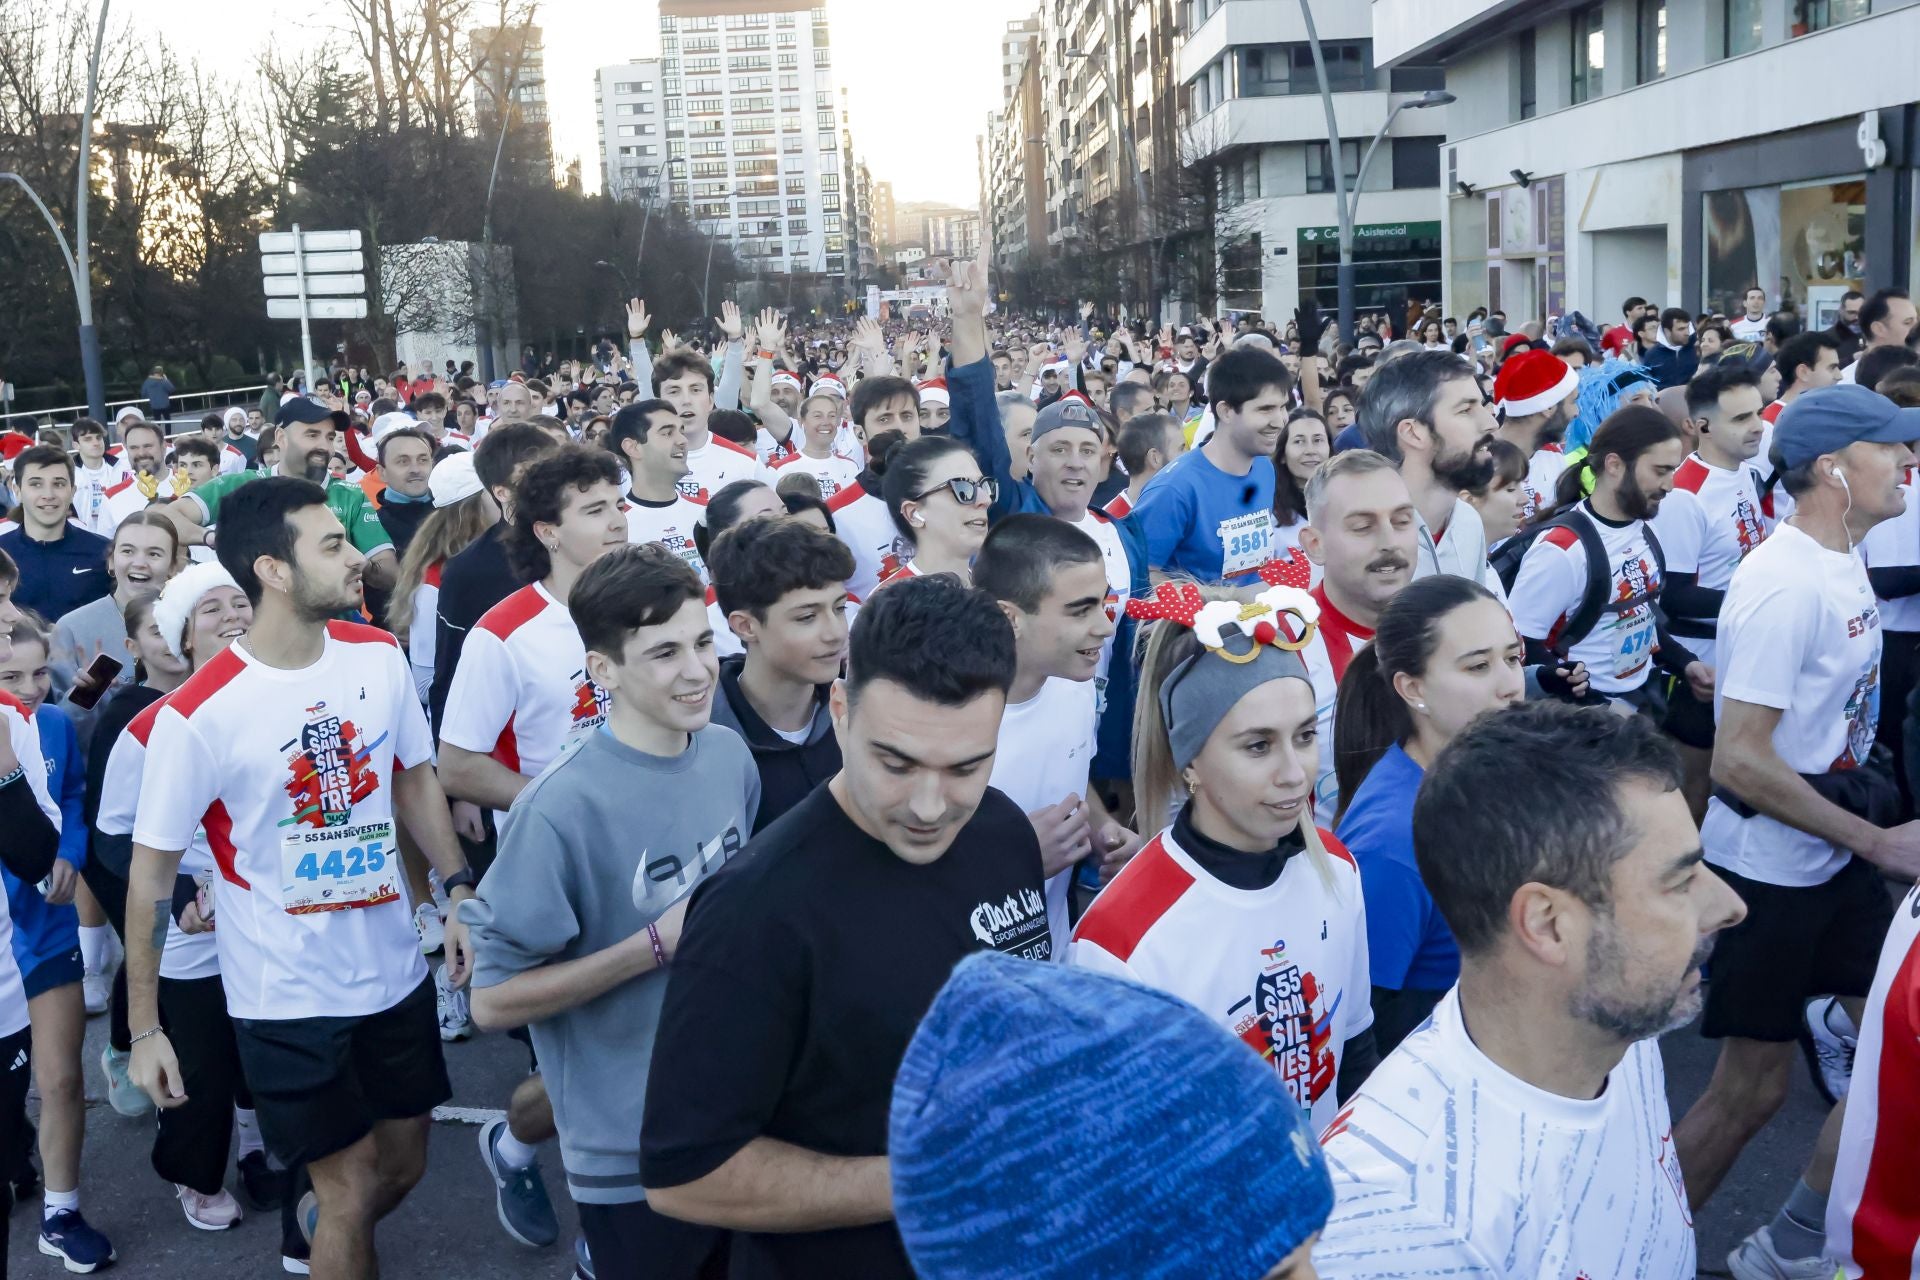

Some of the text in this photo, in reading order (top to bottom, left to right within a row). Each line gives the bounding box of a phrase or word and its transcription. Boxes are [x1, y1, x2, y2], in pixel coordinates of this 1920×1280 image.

[1358, 225, 1407, 237] Asistencial
[683, 482, 699, 494] 55
[1230, 528, 1268, 556] 3581
[1634, 617, 1645, 625] SAN
[1847, 616, 1864, 639] 53
[318, 718, 341, 740] 55
[591, 715, 606, 726] SAN
[309, 734, 341, 755] SAN
[315, 748, 344, 774] SIL
[319, 767, 350, 792] VES
[320, 786, 352, 813] TRE
[305, 822, 390, 843] 55 SAN SILVESTRE
[295, 842, 386, 881] 4425
[982, 894, 1025, 932] Dark
[994, 929, 1017, 944] SPORT
[1275, 968, 1301, 998] 55
[1263, 994, 1306, 1022] SAN
[1271, 1018, 1308, 1053] SIL
[1274, 1044, 1311, 1081] VES
[1286, 1073, 1312, 1110] RE
